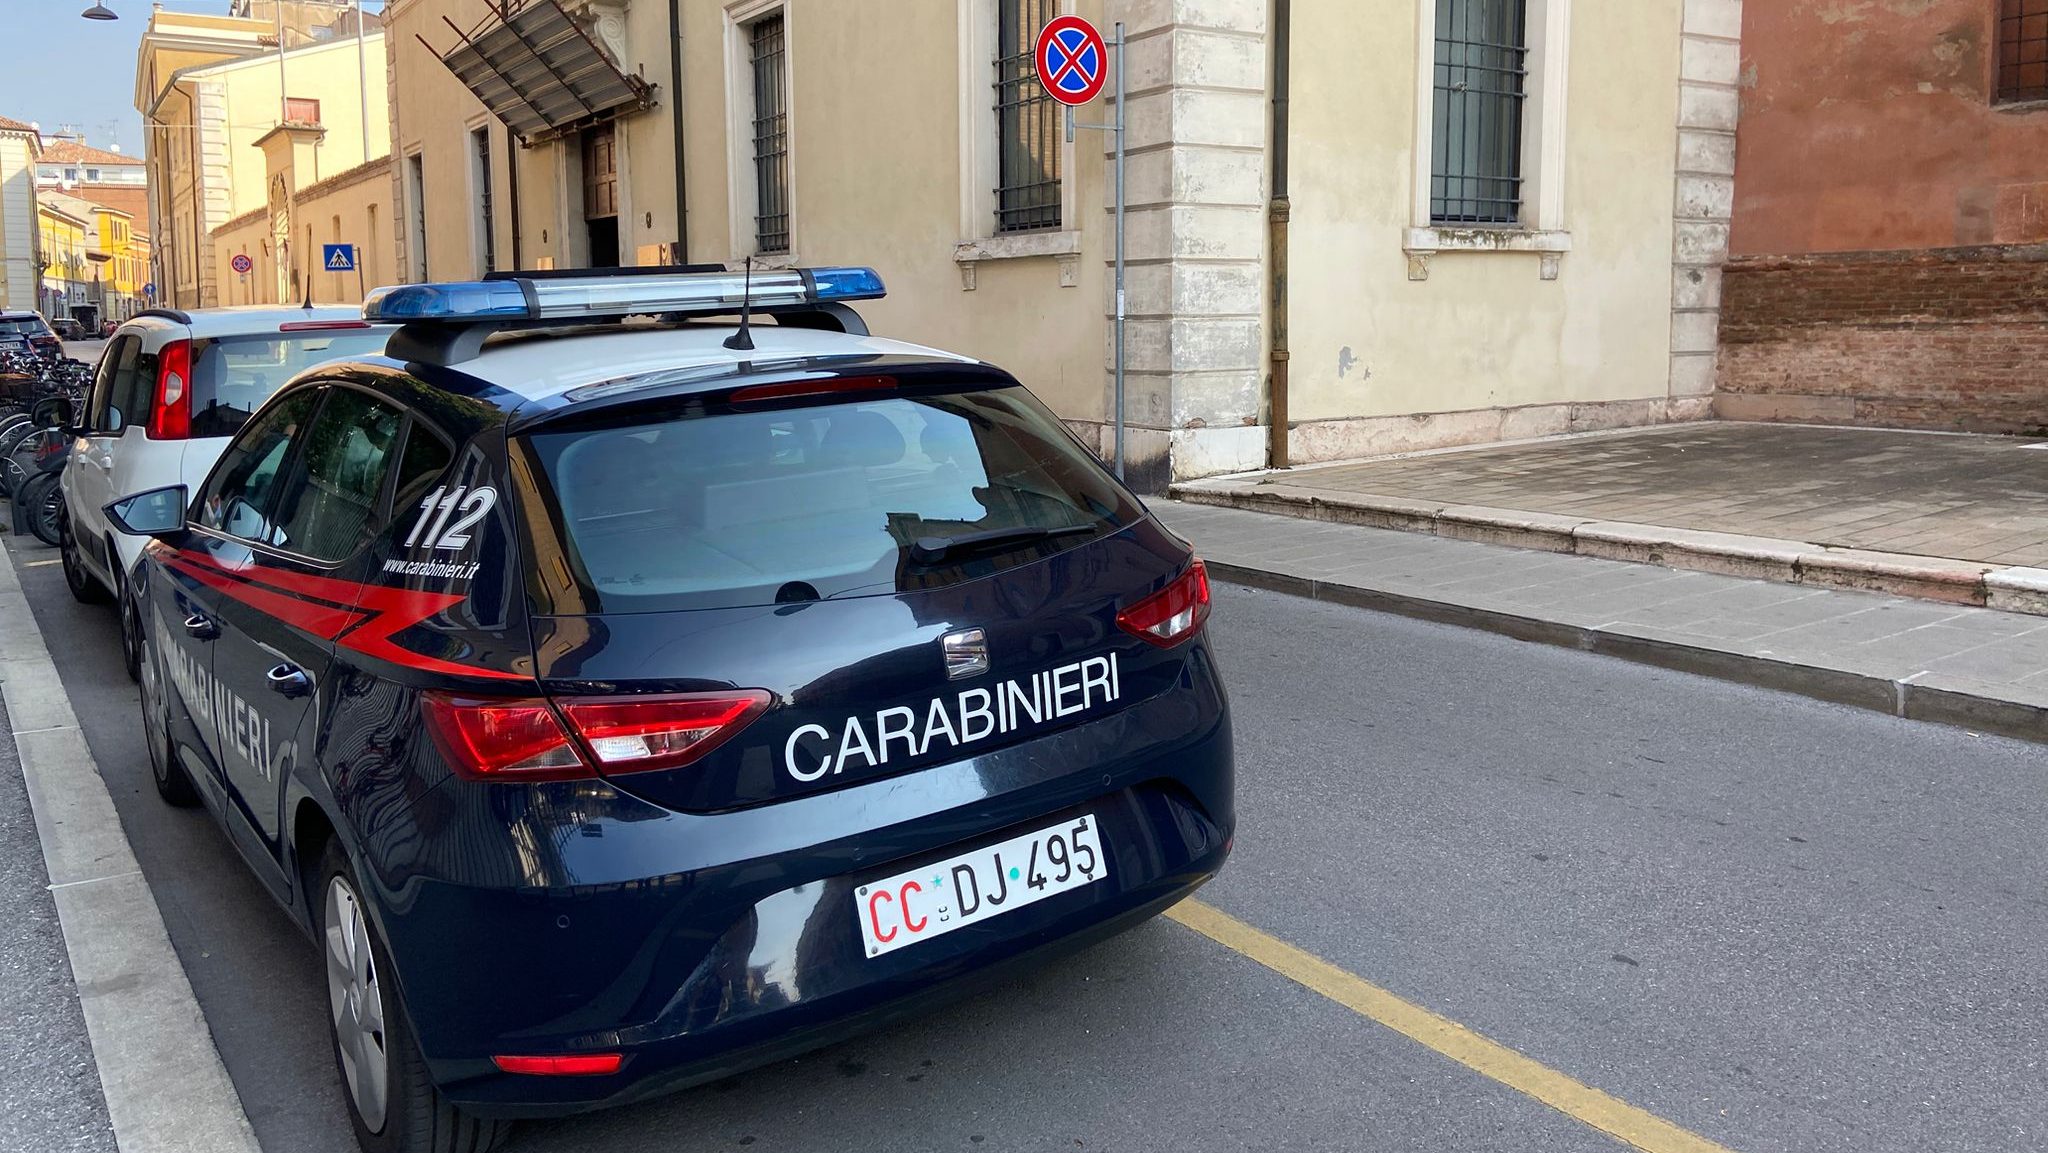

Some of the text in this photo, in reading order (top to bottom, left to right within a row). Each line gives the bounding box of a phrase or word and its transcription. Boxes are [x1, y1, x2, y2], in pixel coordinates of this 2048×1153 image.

[382, 558, 480, 580] www.carabinieri.it
[403, 485, 498, 550] 112
[164, 632, 272, 783] RABINIERI
[784, 652, 1121, 783] CARABINIERI
[868, 880, 928, 943] CC
[1027, 824, 1096, 891] 495
